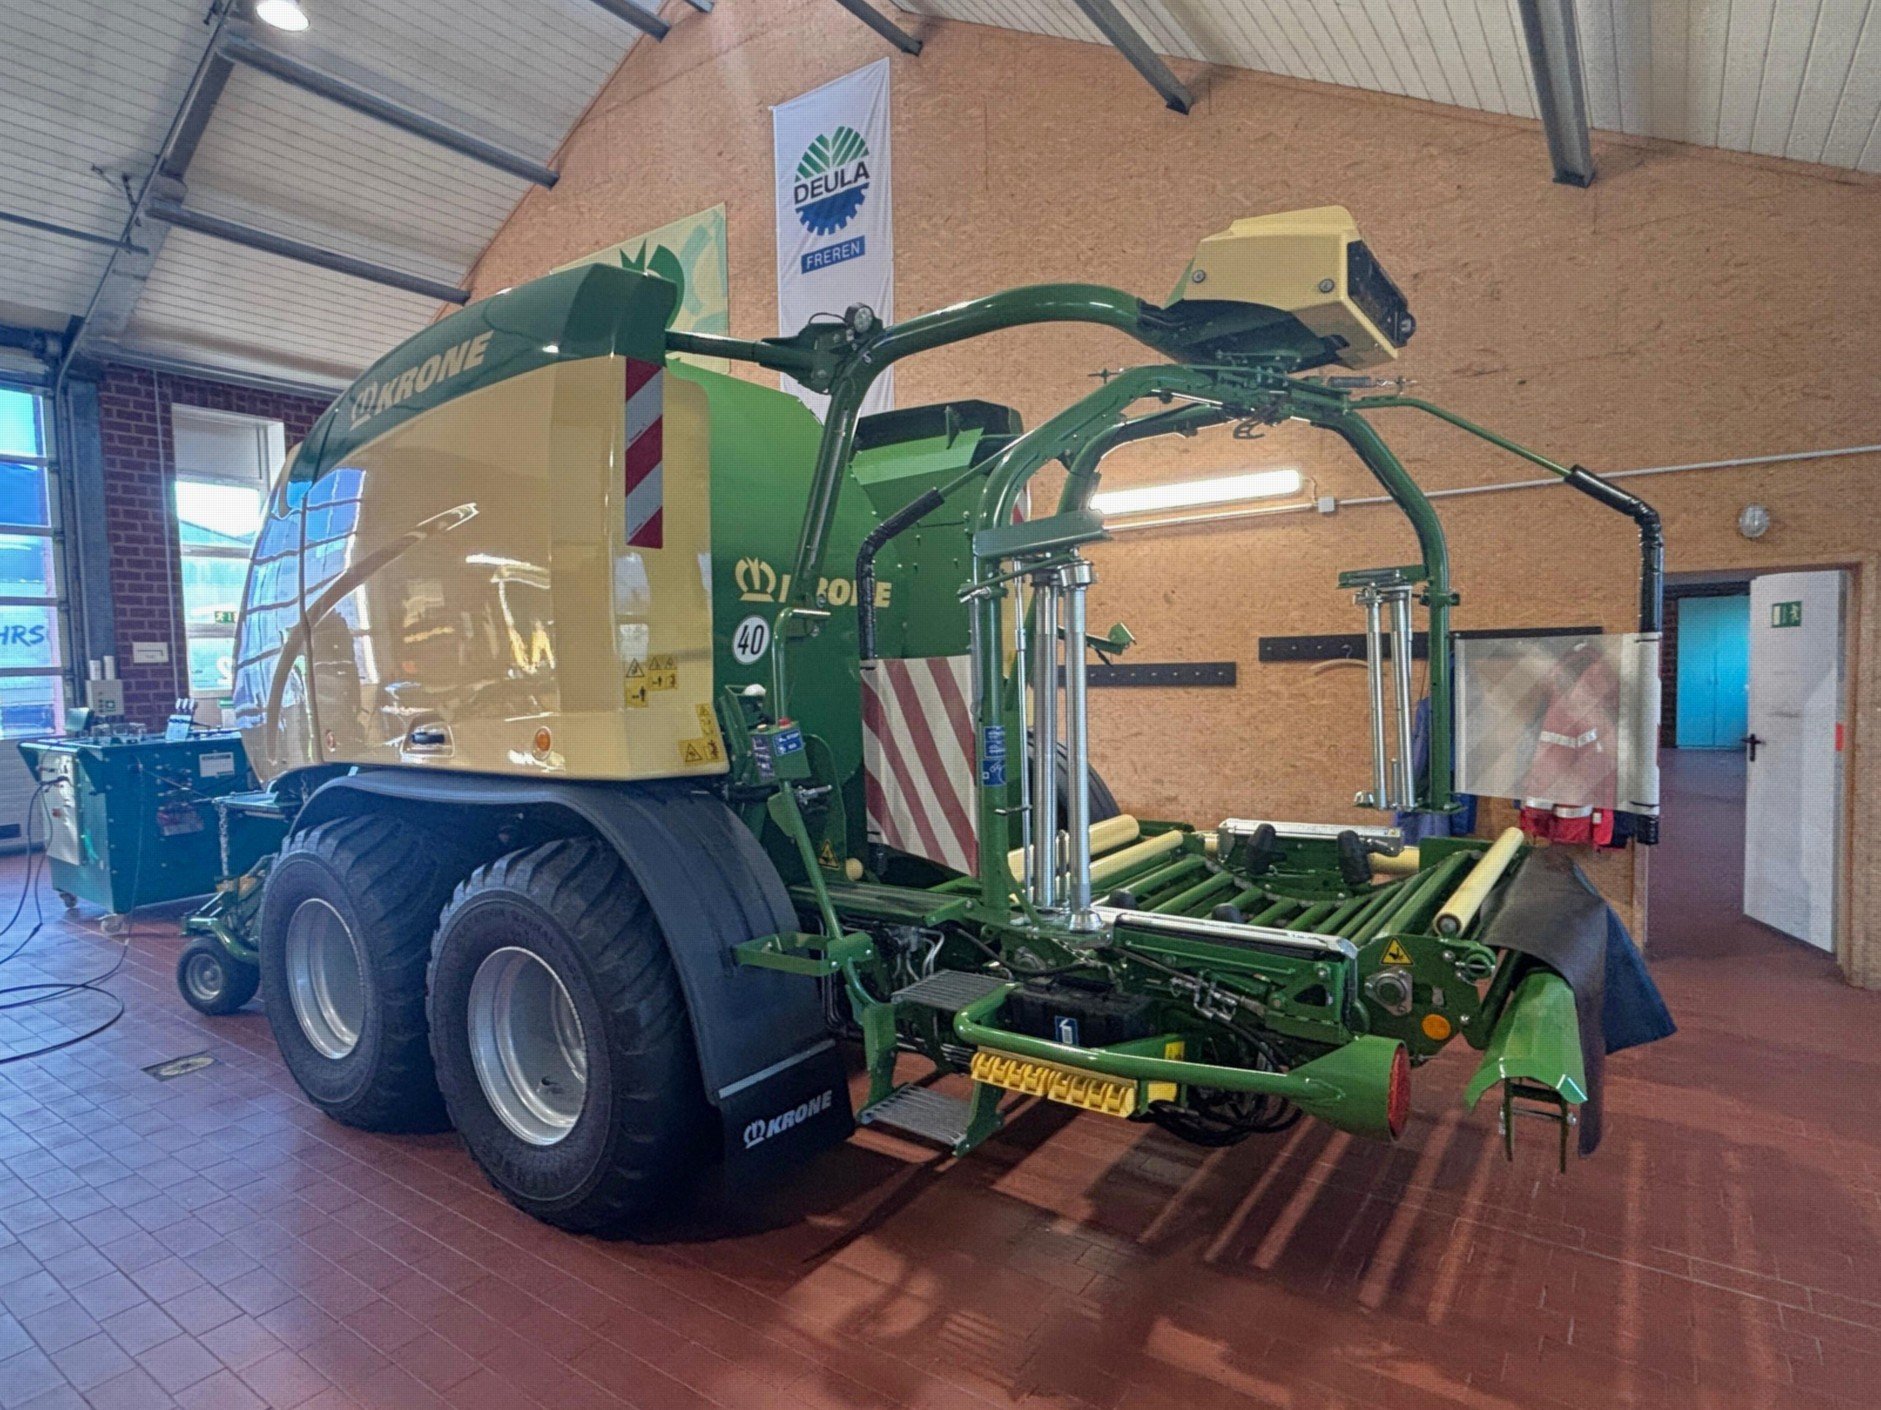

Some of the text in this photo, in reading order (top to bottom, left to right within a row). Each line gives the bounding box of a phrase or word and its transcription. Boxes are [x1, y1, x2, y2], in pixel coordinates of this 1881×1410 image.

[793, 161, 870, 204] DEULA
[806, 241, 860, 269] FREREN
[374, 330, 494, 416] KRONE
[738, 625, 764, 655] 40
[766, 1089, 833, 1138] KRONE
